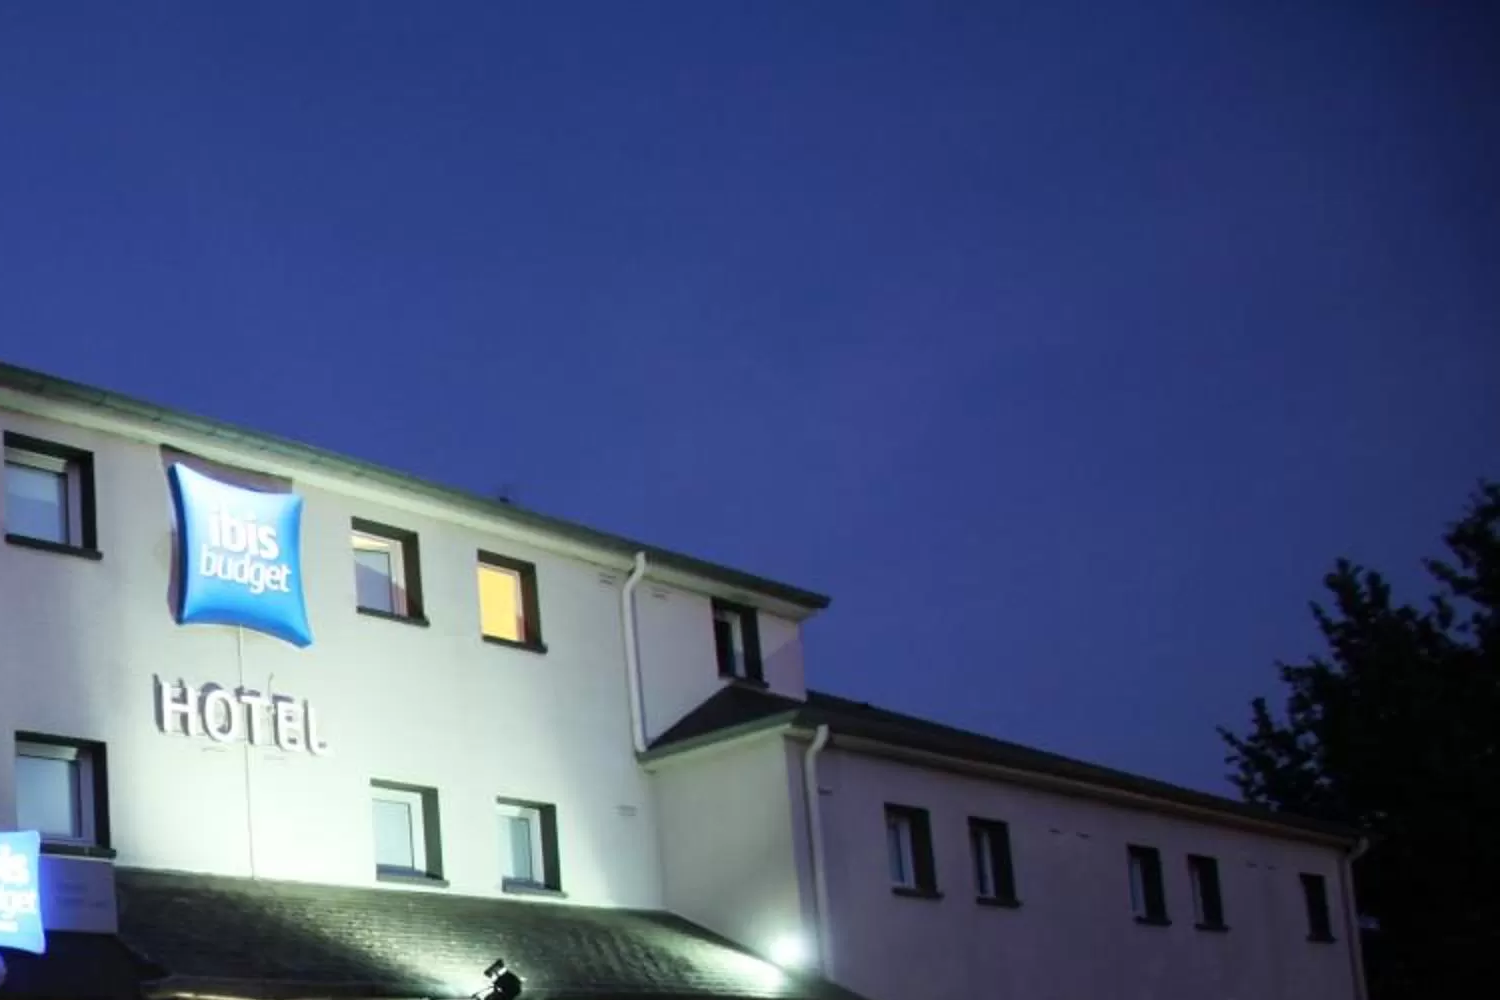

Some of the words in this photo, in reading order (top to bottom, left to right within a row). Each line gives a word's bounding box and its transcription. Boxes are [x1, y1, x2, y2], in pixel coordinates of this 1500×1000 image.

[209, 507, 279, 560] ibis
[200, 545, 292, 593] budget
[156, 677, 329, 755] HOTEL
